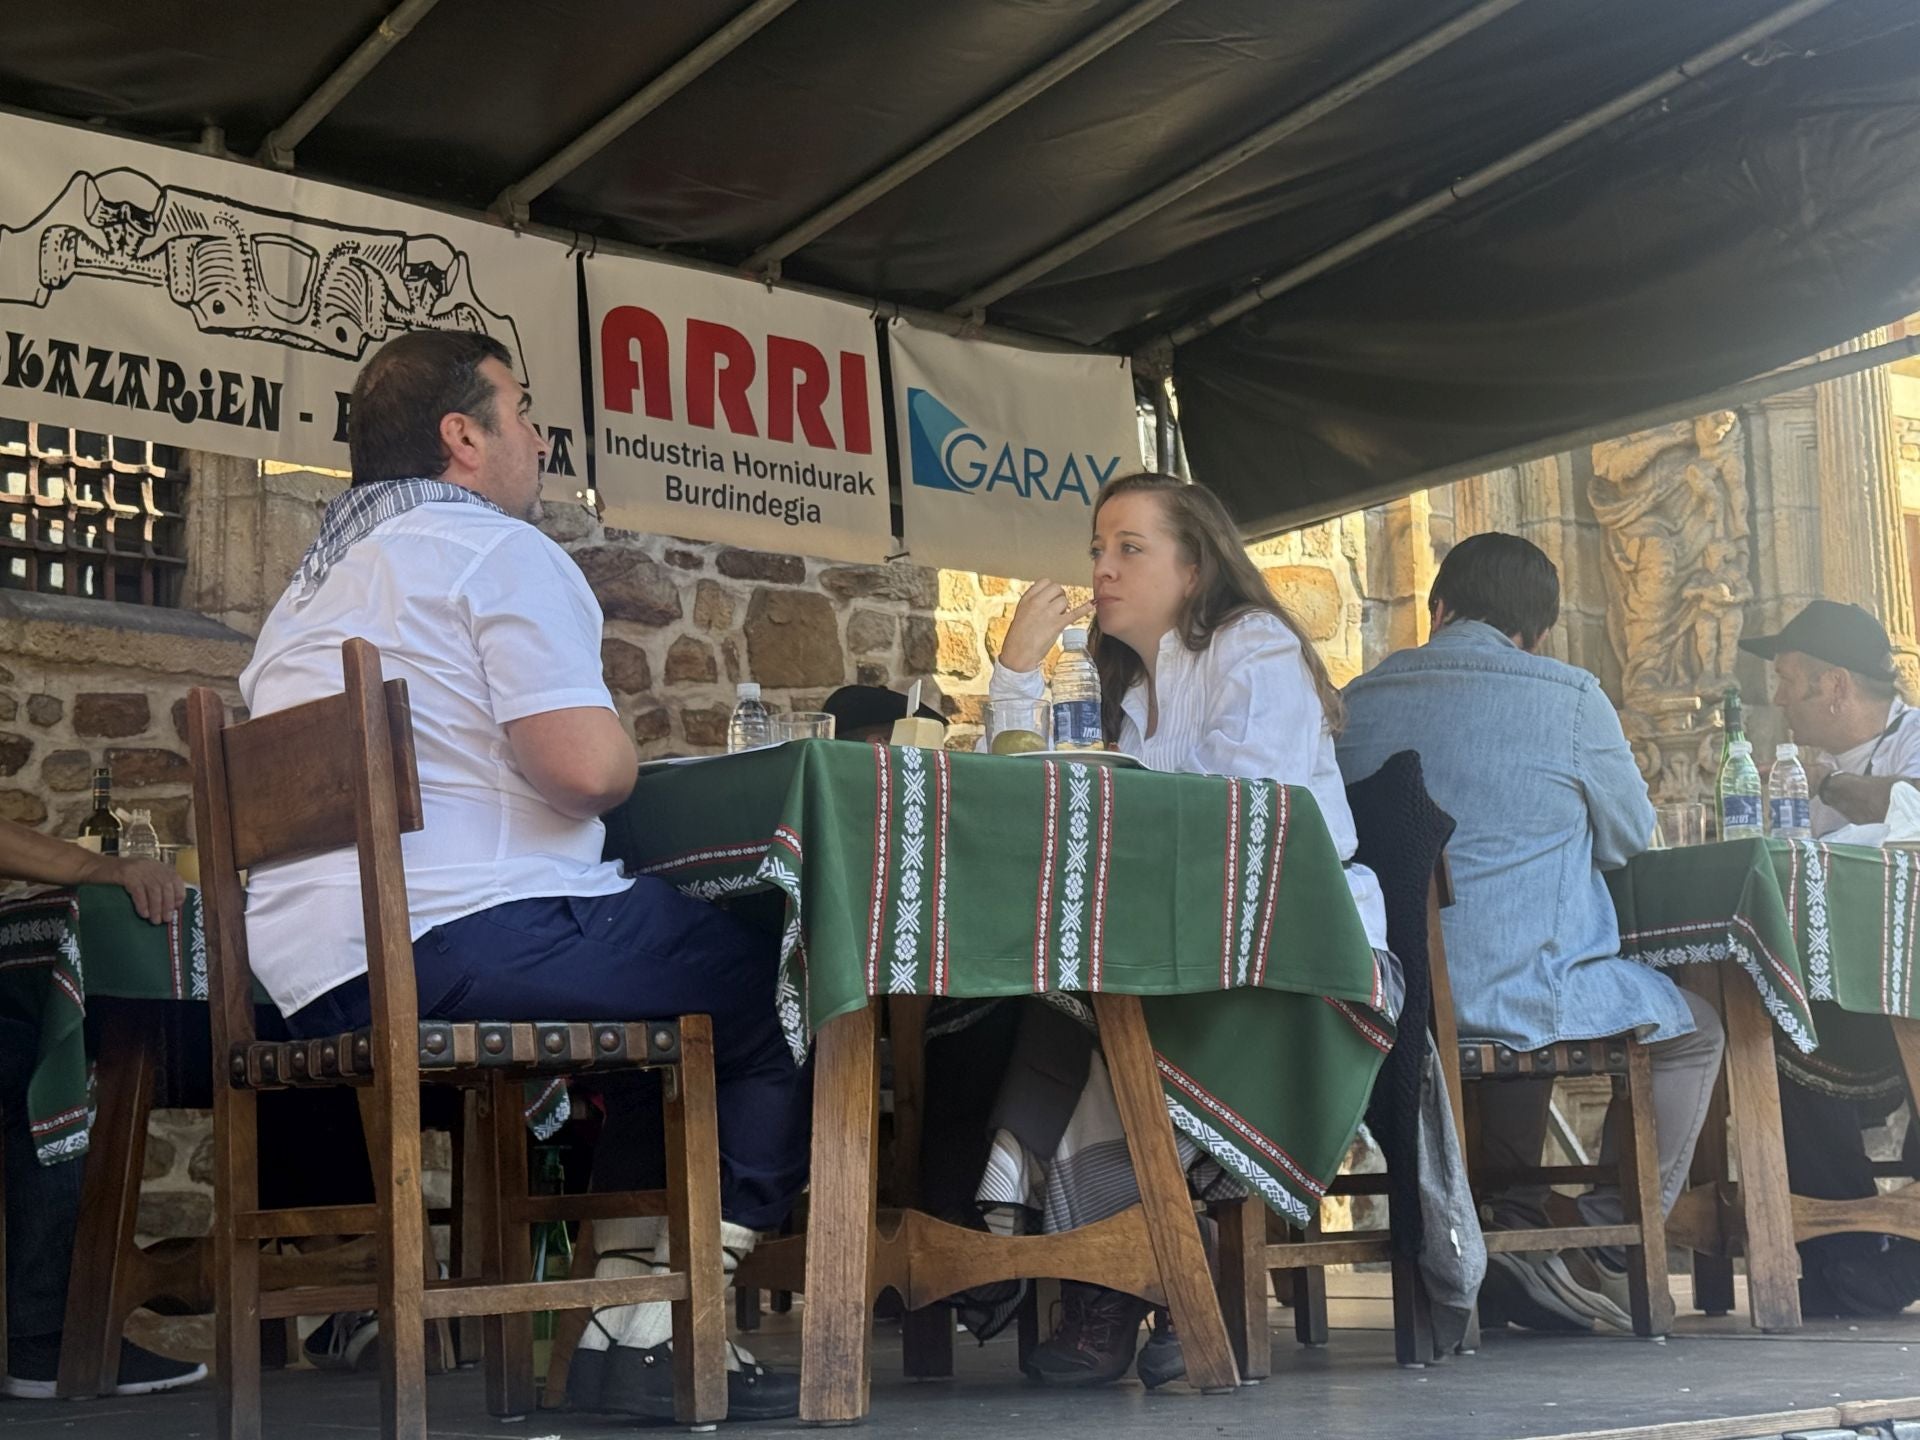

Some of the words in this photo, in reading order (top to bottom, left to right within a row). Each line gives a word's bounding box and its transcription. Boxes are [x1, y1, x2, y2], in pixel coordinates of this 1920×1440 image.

[602, 305, 872, 455] ARRI
[606, 428, 725, 473] Industria
[733, 451, 875, 496] Hornidurak
[946, 433, 1121, 506] GARAY
[665, 475, 821, 526] Burdindegia
